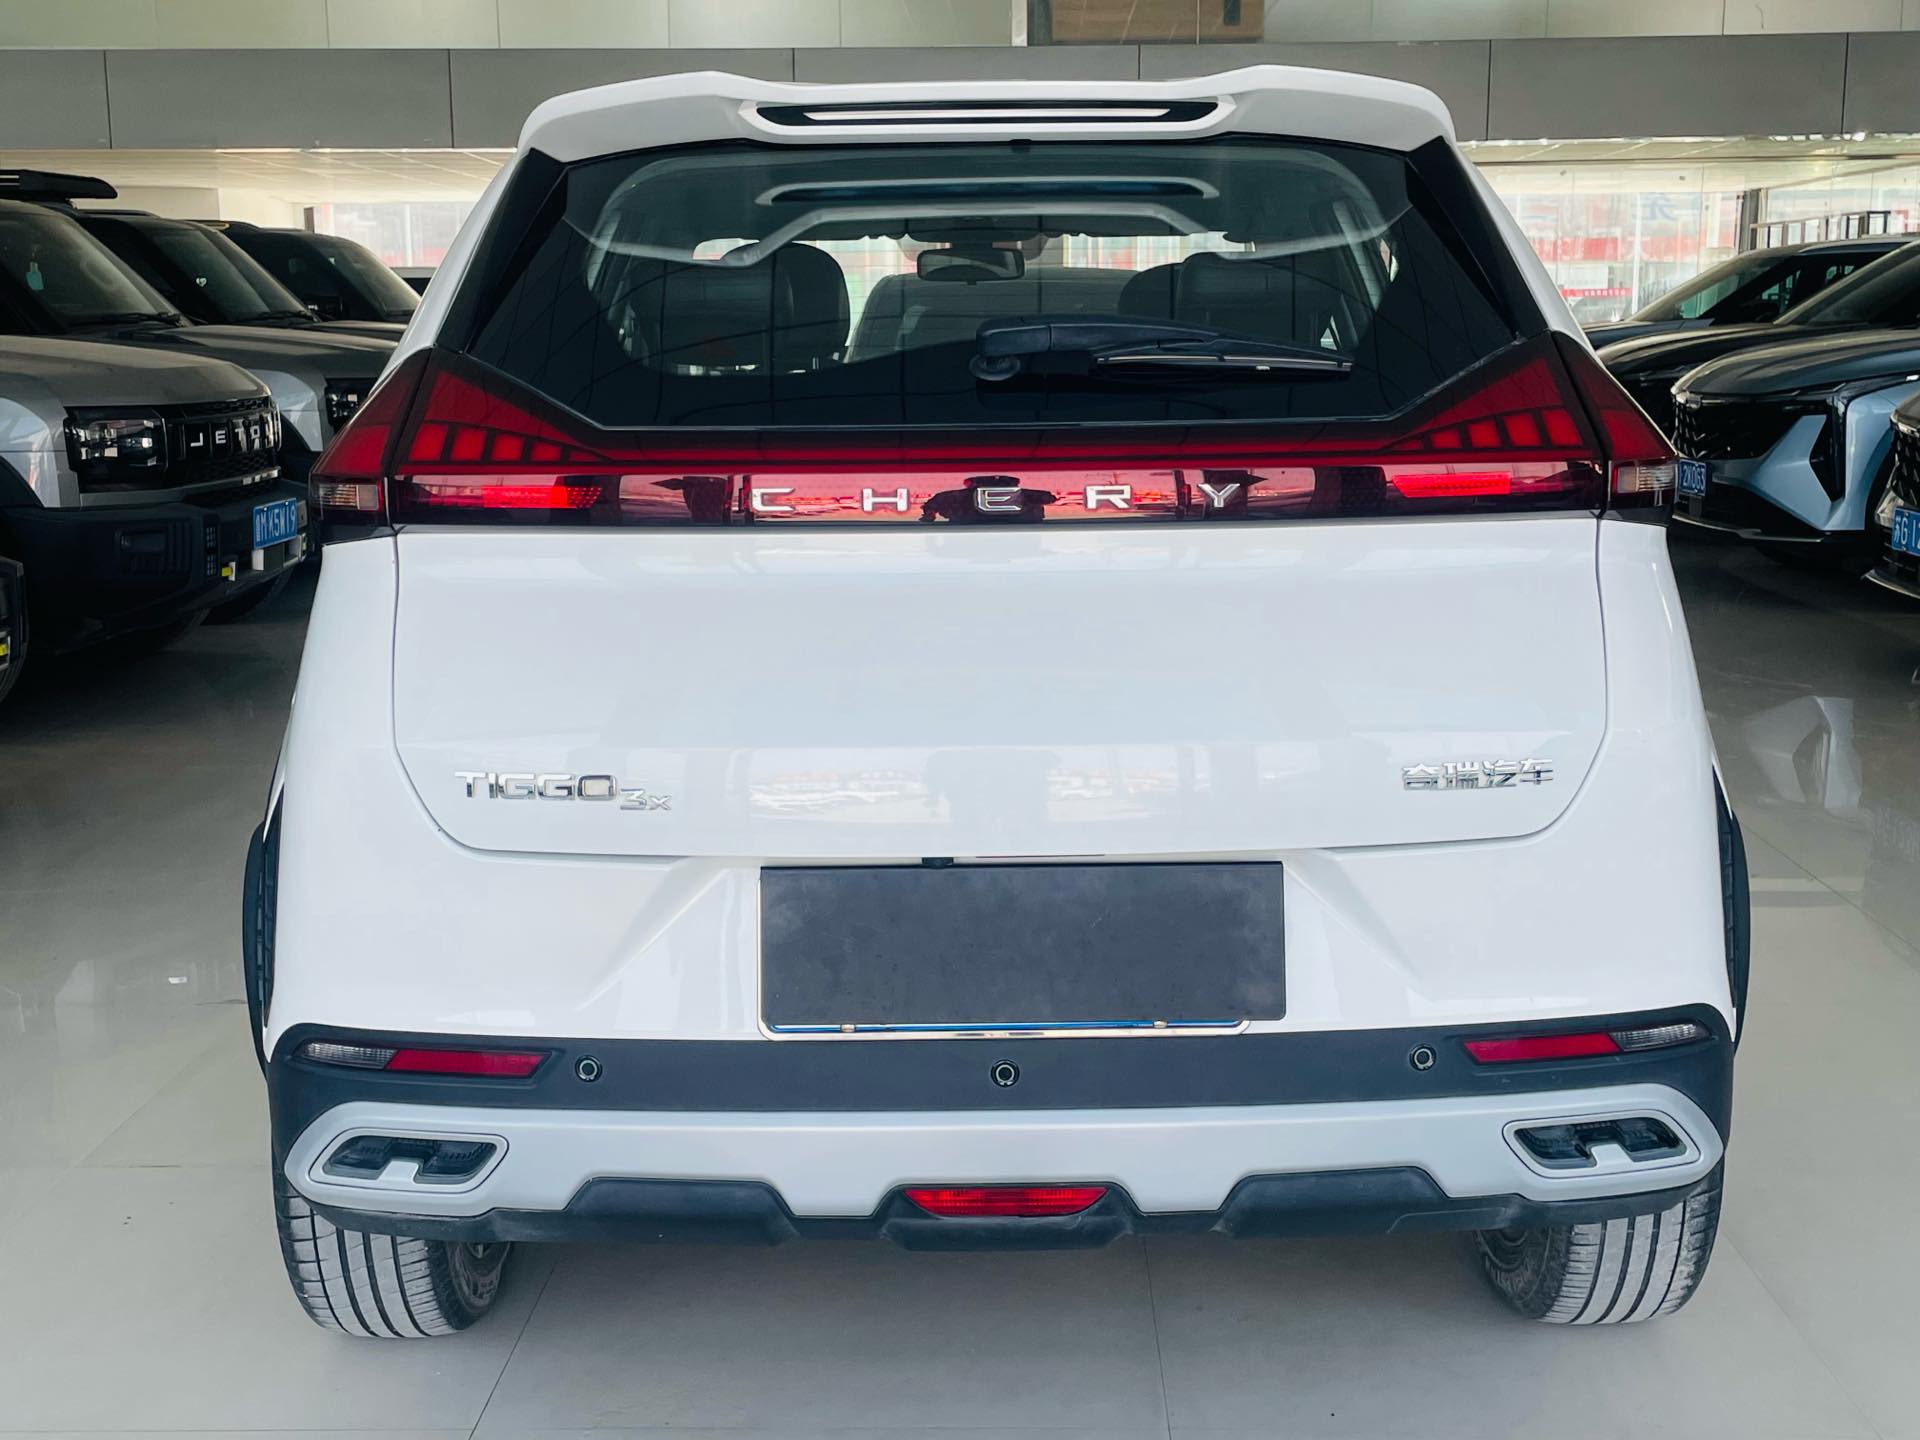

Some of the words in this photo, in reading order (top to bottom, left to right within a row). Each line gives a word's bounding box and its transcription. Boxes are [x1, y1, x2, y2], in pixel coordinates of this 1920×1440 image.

[752, 483, 1240, 512] CHERY
[454, 771, 617, 801] TIGGO
[1402, 758, 1553, 791] 奇瑞汽车
